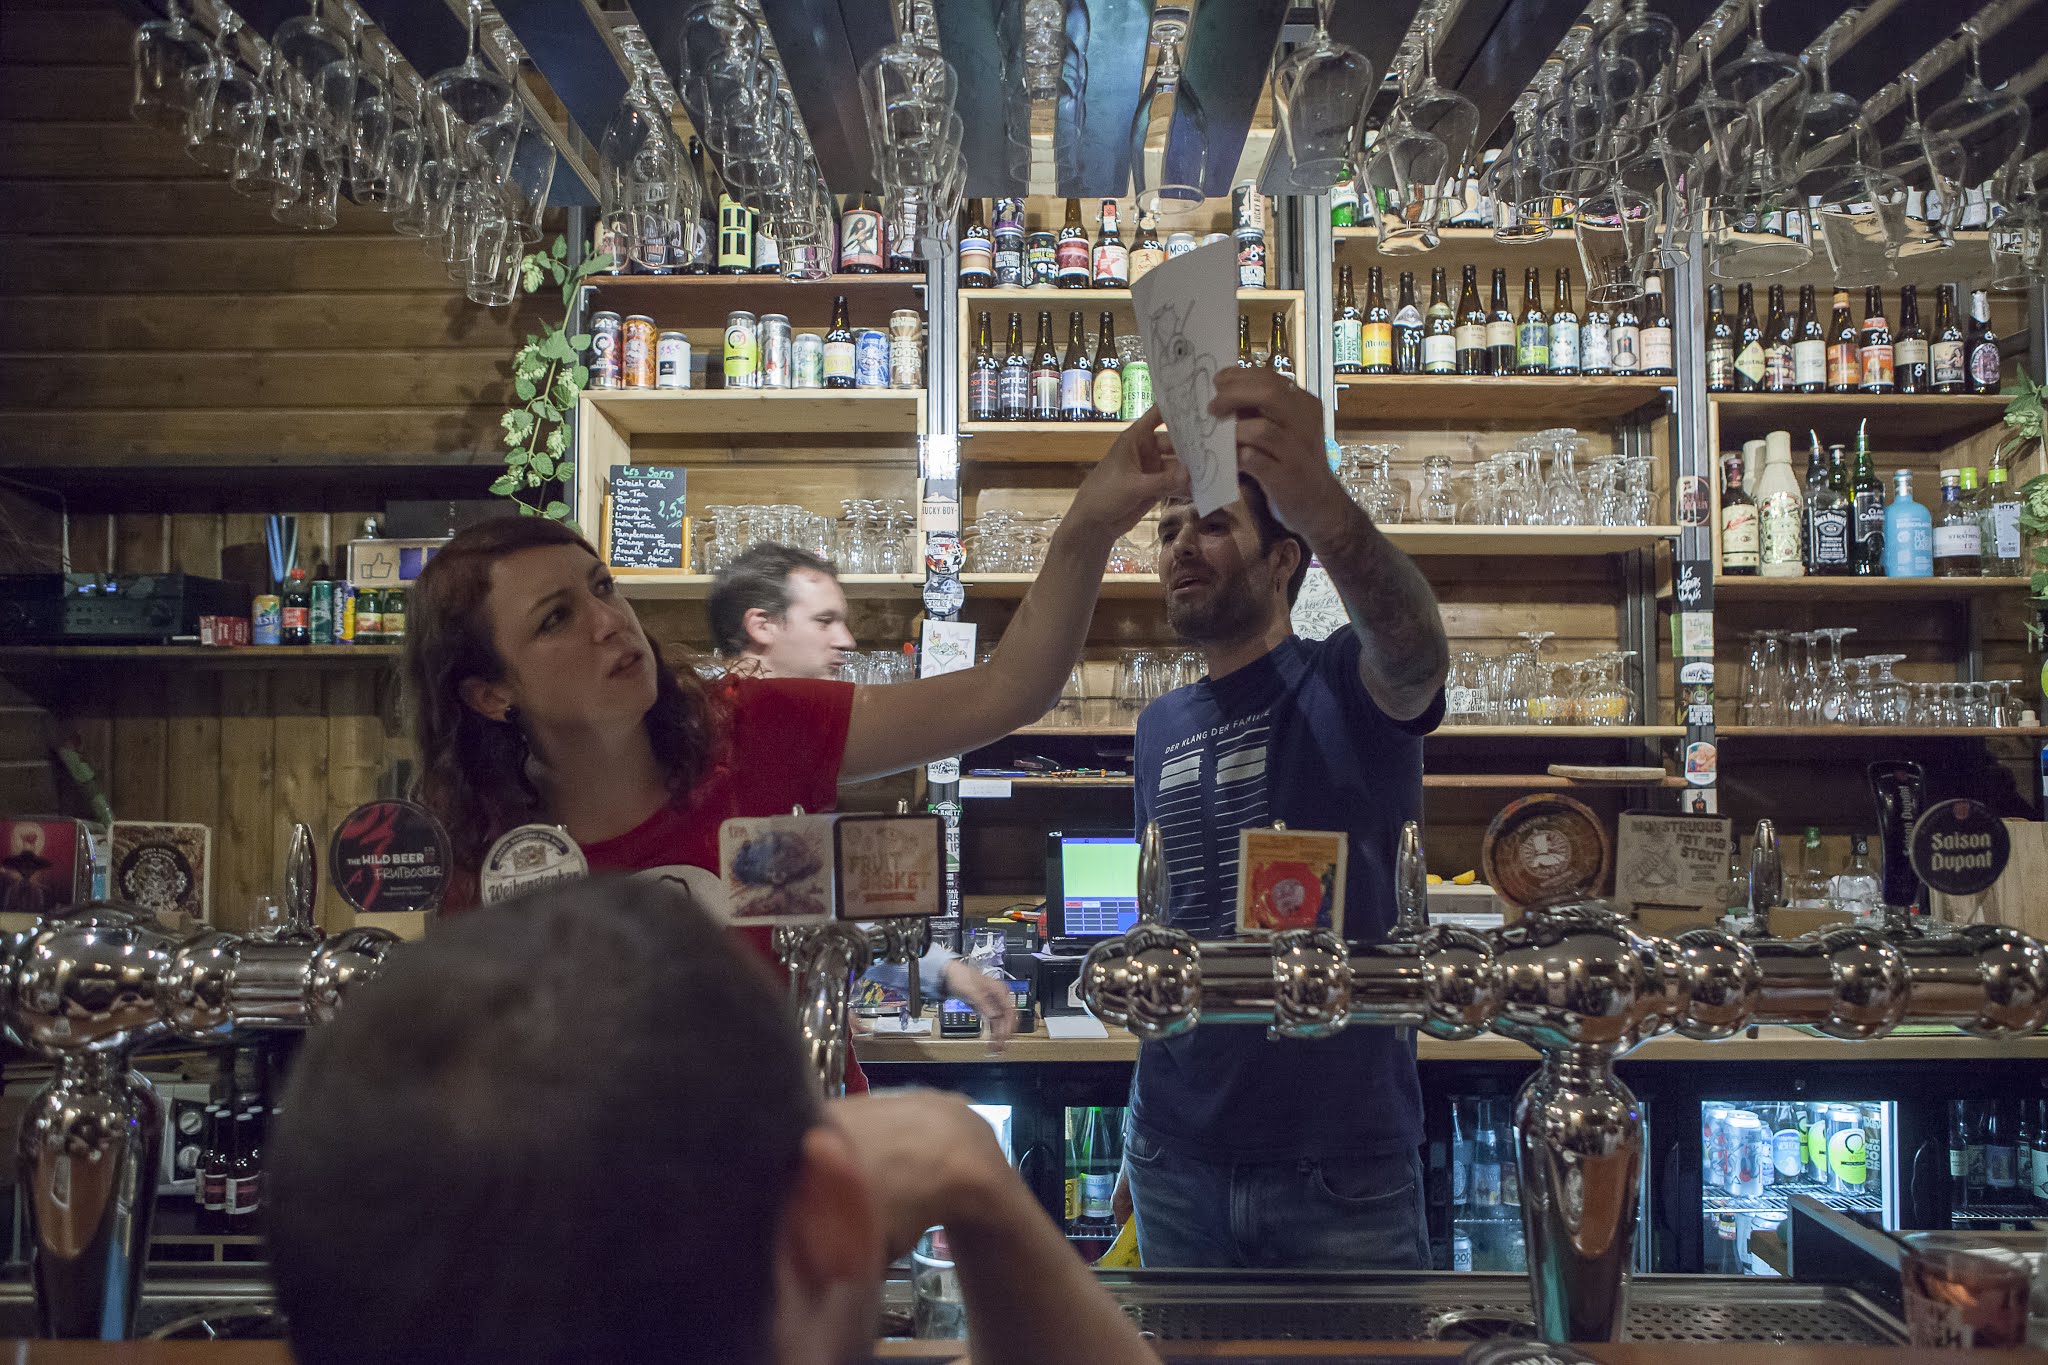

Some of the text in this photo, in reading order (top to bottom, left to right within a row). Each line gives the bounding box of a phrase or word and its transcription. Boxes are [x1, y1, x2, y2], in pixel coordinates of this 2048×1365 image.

[1165, 742, 1180, 754] DER
[1181, 731, 1208, 747] KLANG
[1211, 723, 1230, 737] DER
[1676, 833, 1701, 846] FAT
[1931, 832, 1992, 851] Saison
[362, 854, 391, 865] WILD
[392, 853, 425, 864] BEER
[1681, 846, 1725, 862] STOUT
[1931, 850, 1993, 872] Dupont
